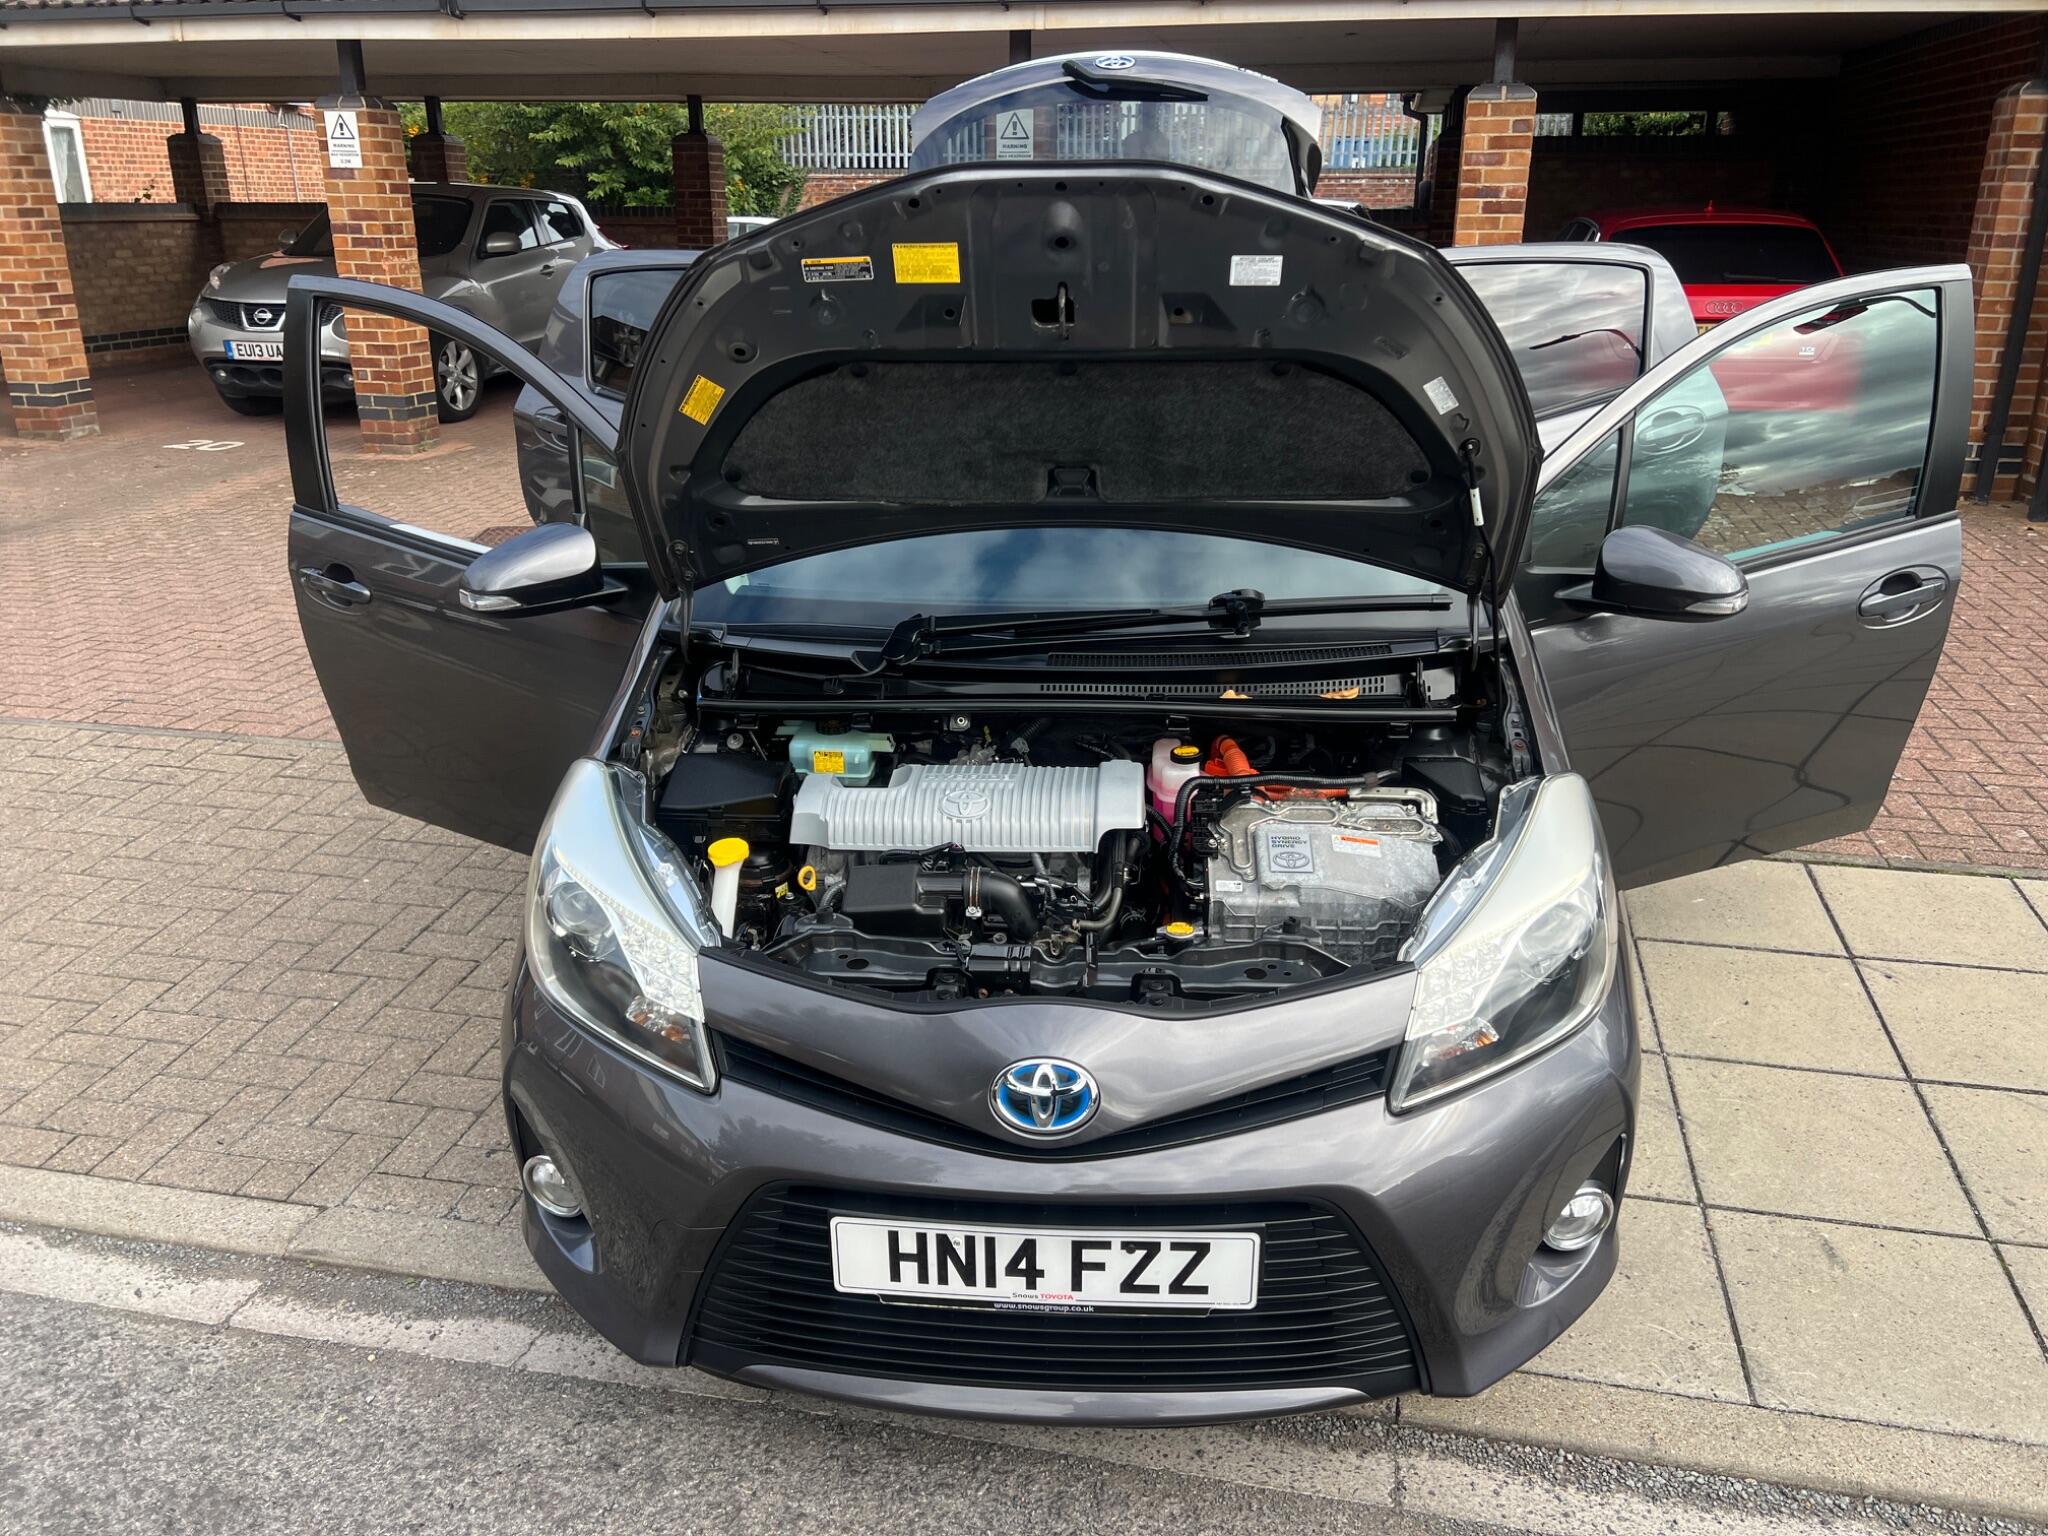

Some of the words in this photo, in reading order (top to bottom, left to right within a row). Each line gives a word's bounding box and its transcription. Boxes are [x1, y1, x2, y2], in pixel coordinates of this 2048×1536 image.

[236, 343, 264, 357] EU13
[162, 439, 245, 451] 20
[888, 1230, 1045, 1290] HN14
[1071, 1240, 1211, 1295] FZZ
[993, 1302, 1094, 1312] www.snowsgroup.co.uk
